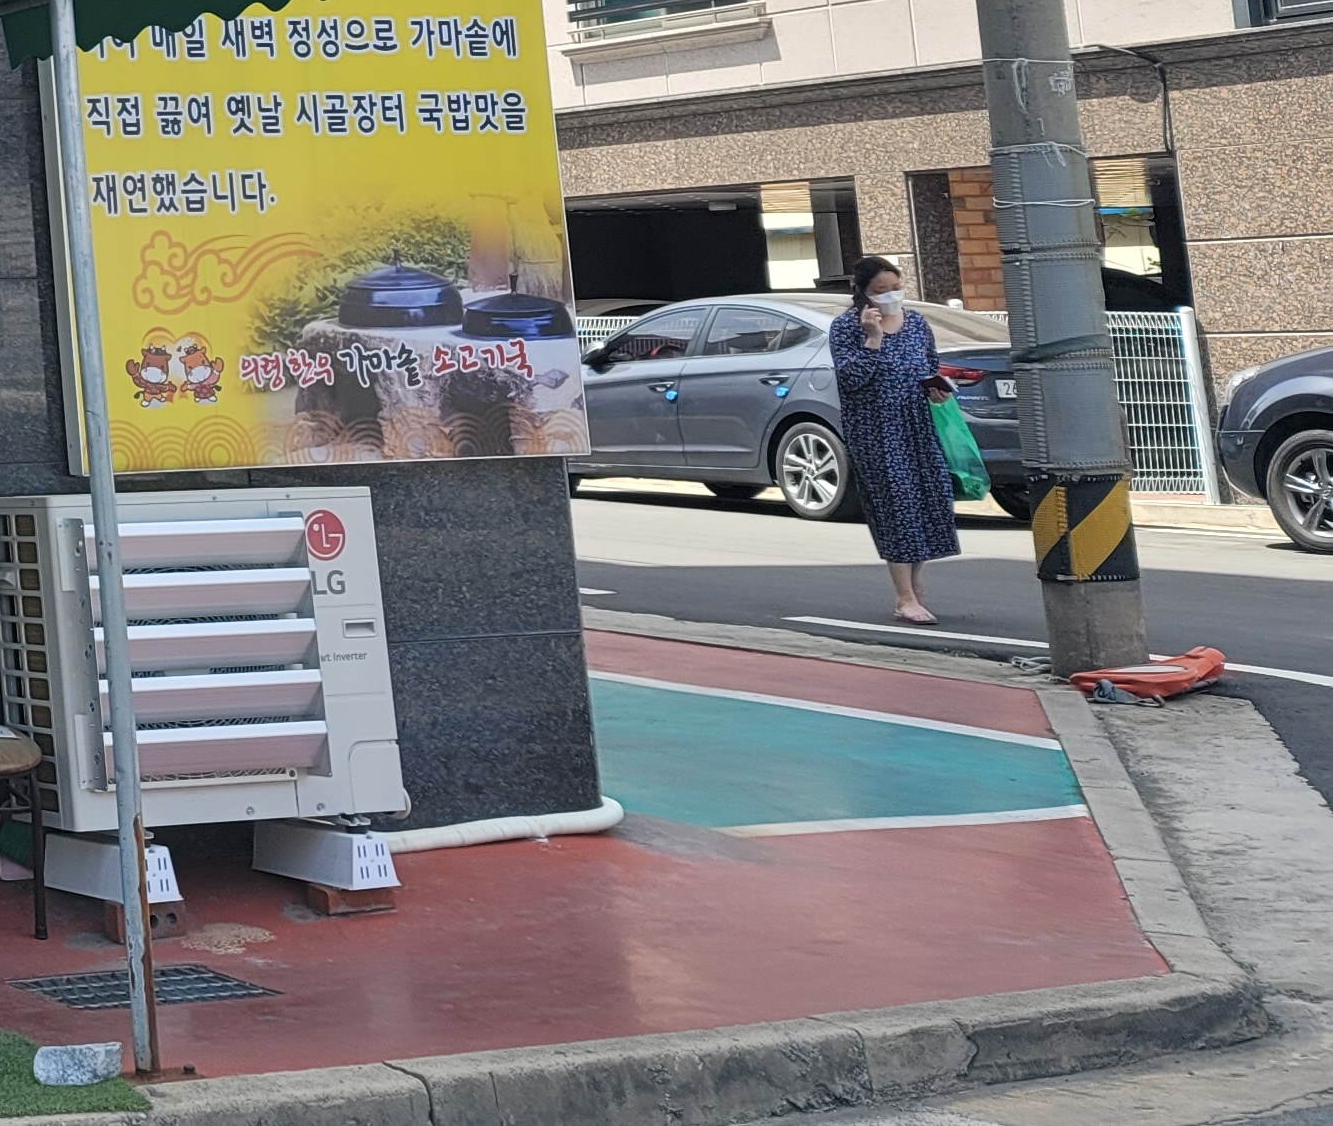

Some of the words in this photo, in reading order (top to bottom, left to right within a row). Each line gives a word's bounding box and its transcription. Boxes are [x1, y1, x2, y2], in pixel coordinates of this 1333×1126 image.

[222, 19, 275, 58] 새벽
[287, 19, 398, 58] 정성으로
[410, 18, 519, 58] 가마솥에
[87, 95, 141, 136] 직접
[156, 96, 213, 136] 끓여
[227, 95, 283, 134] 옛날
[296, 94, 406, 134] 시골장터
[417, 92, 527, 133] 국밥맛을
[92, 172, 276, 215] 재연했습니다.
[240, 353, 284, 391] 의령
[287, 348, 334, 387] 한우
[337, 340, 421, 387] 가마솥
[433, 338, 533, 379] 소고기국
[311, 569, 346, 595] LG
[333, 652, 367, 662] Inverter
